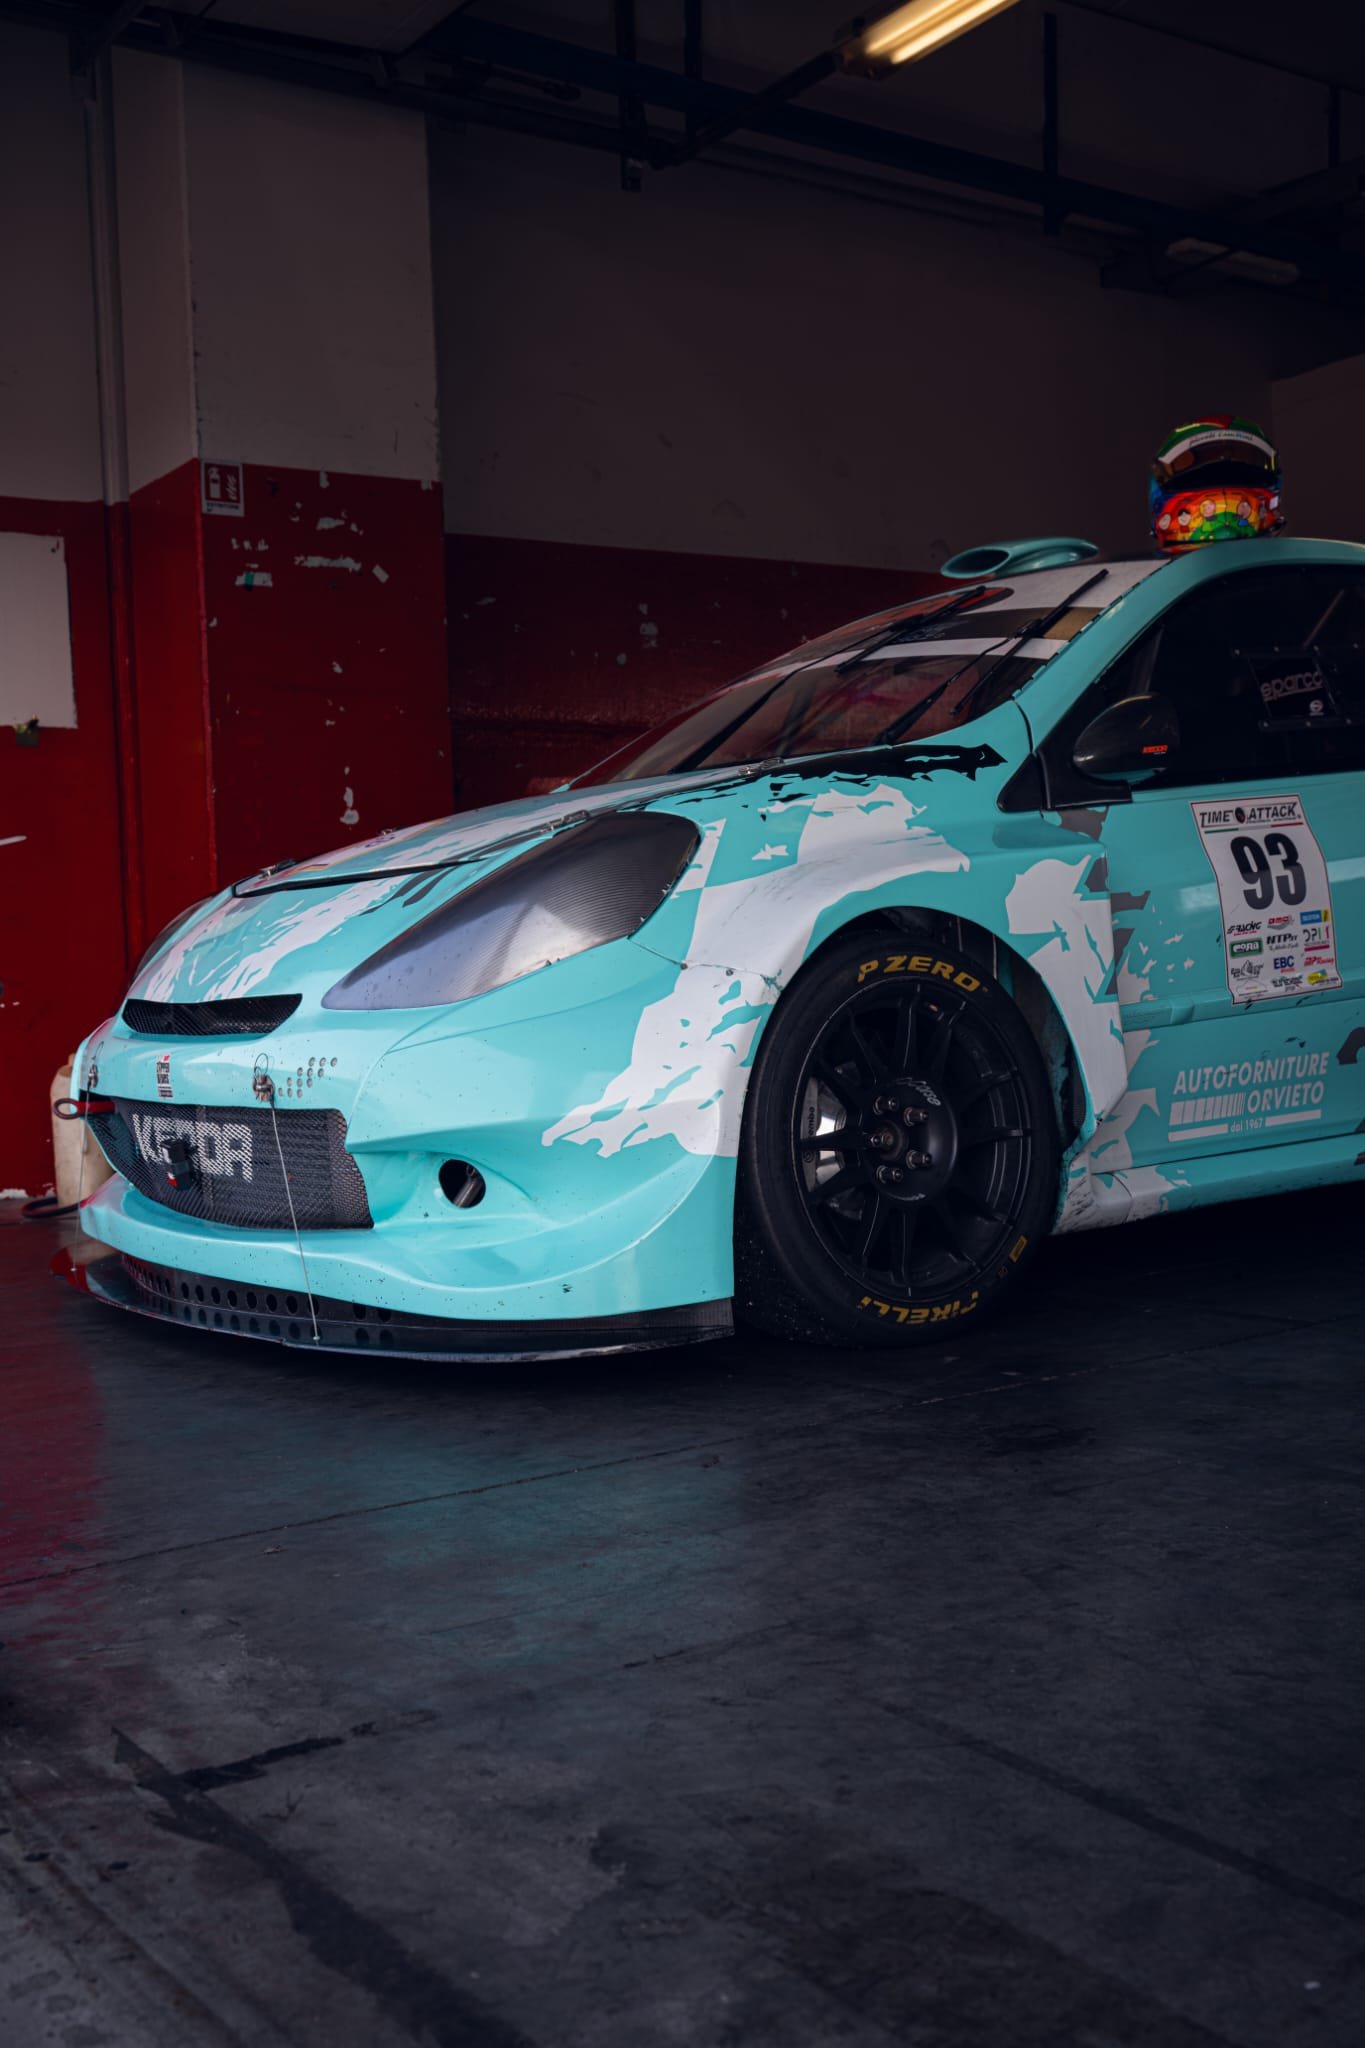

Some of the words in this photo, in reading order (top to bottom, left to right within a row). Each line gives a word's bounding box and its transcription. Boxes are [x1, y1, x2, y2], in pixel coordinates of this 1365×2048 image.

[1200, 809, 1233, 828] TIME
[1247, 801, 1298, 820] ATTACK
[1230, 832, 1307, 910] 93
[857, 959, 880, 983] P
[883, 954, 979, 991] ZERO
[1273, 955, 1295, 970] EBC
[1173, 1051, 1330, 1095] AUTOFORNITURE
[1247, 1081, 1325, 1114] ORVIETO
[1245, 1118, 1264, 1131] 1967
[859, 1290, 979, 1324] PIRELLI
